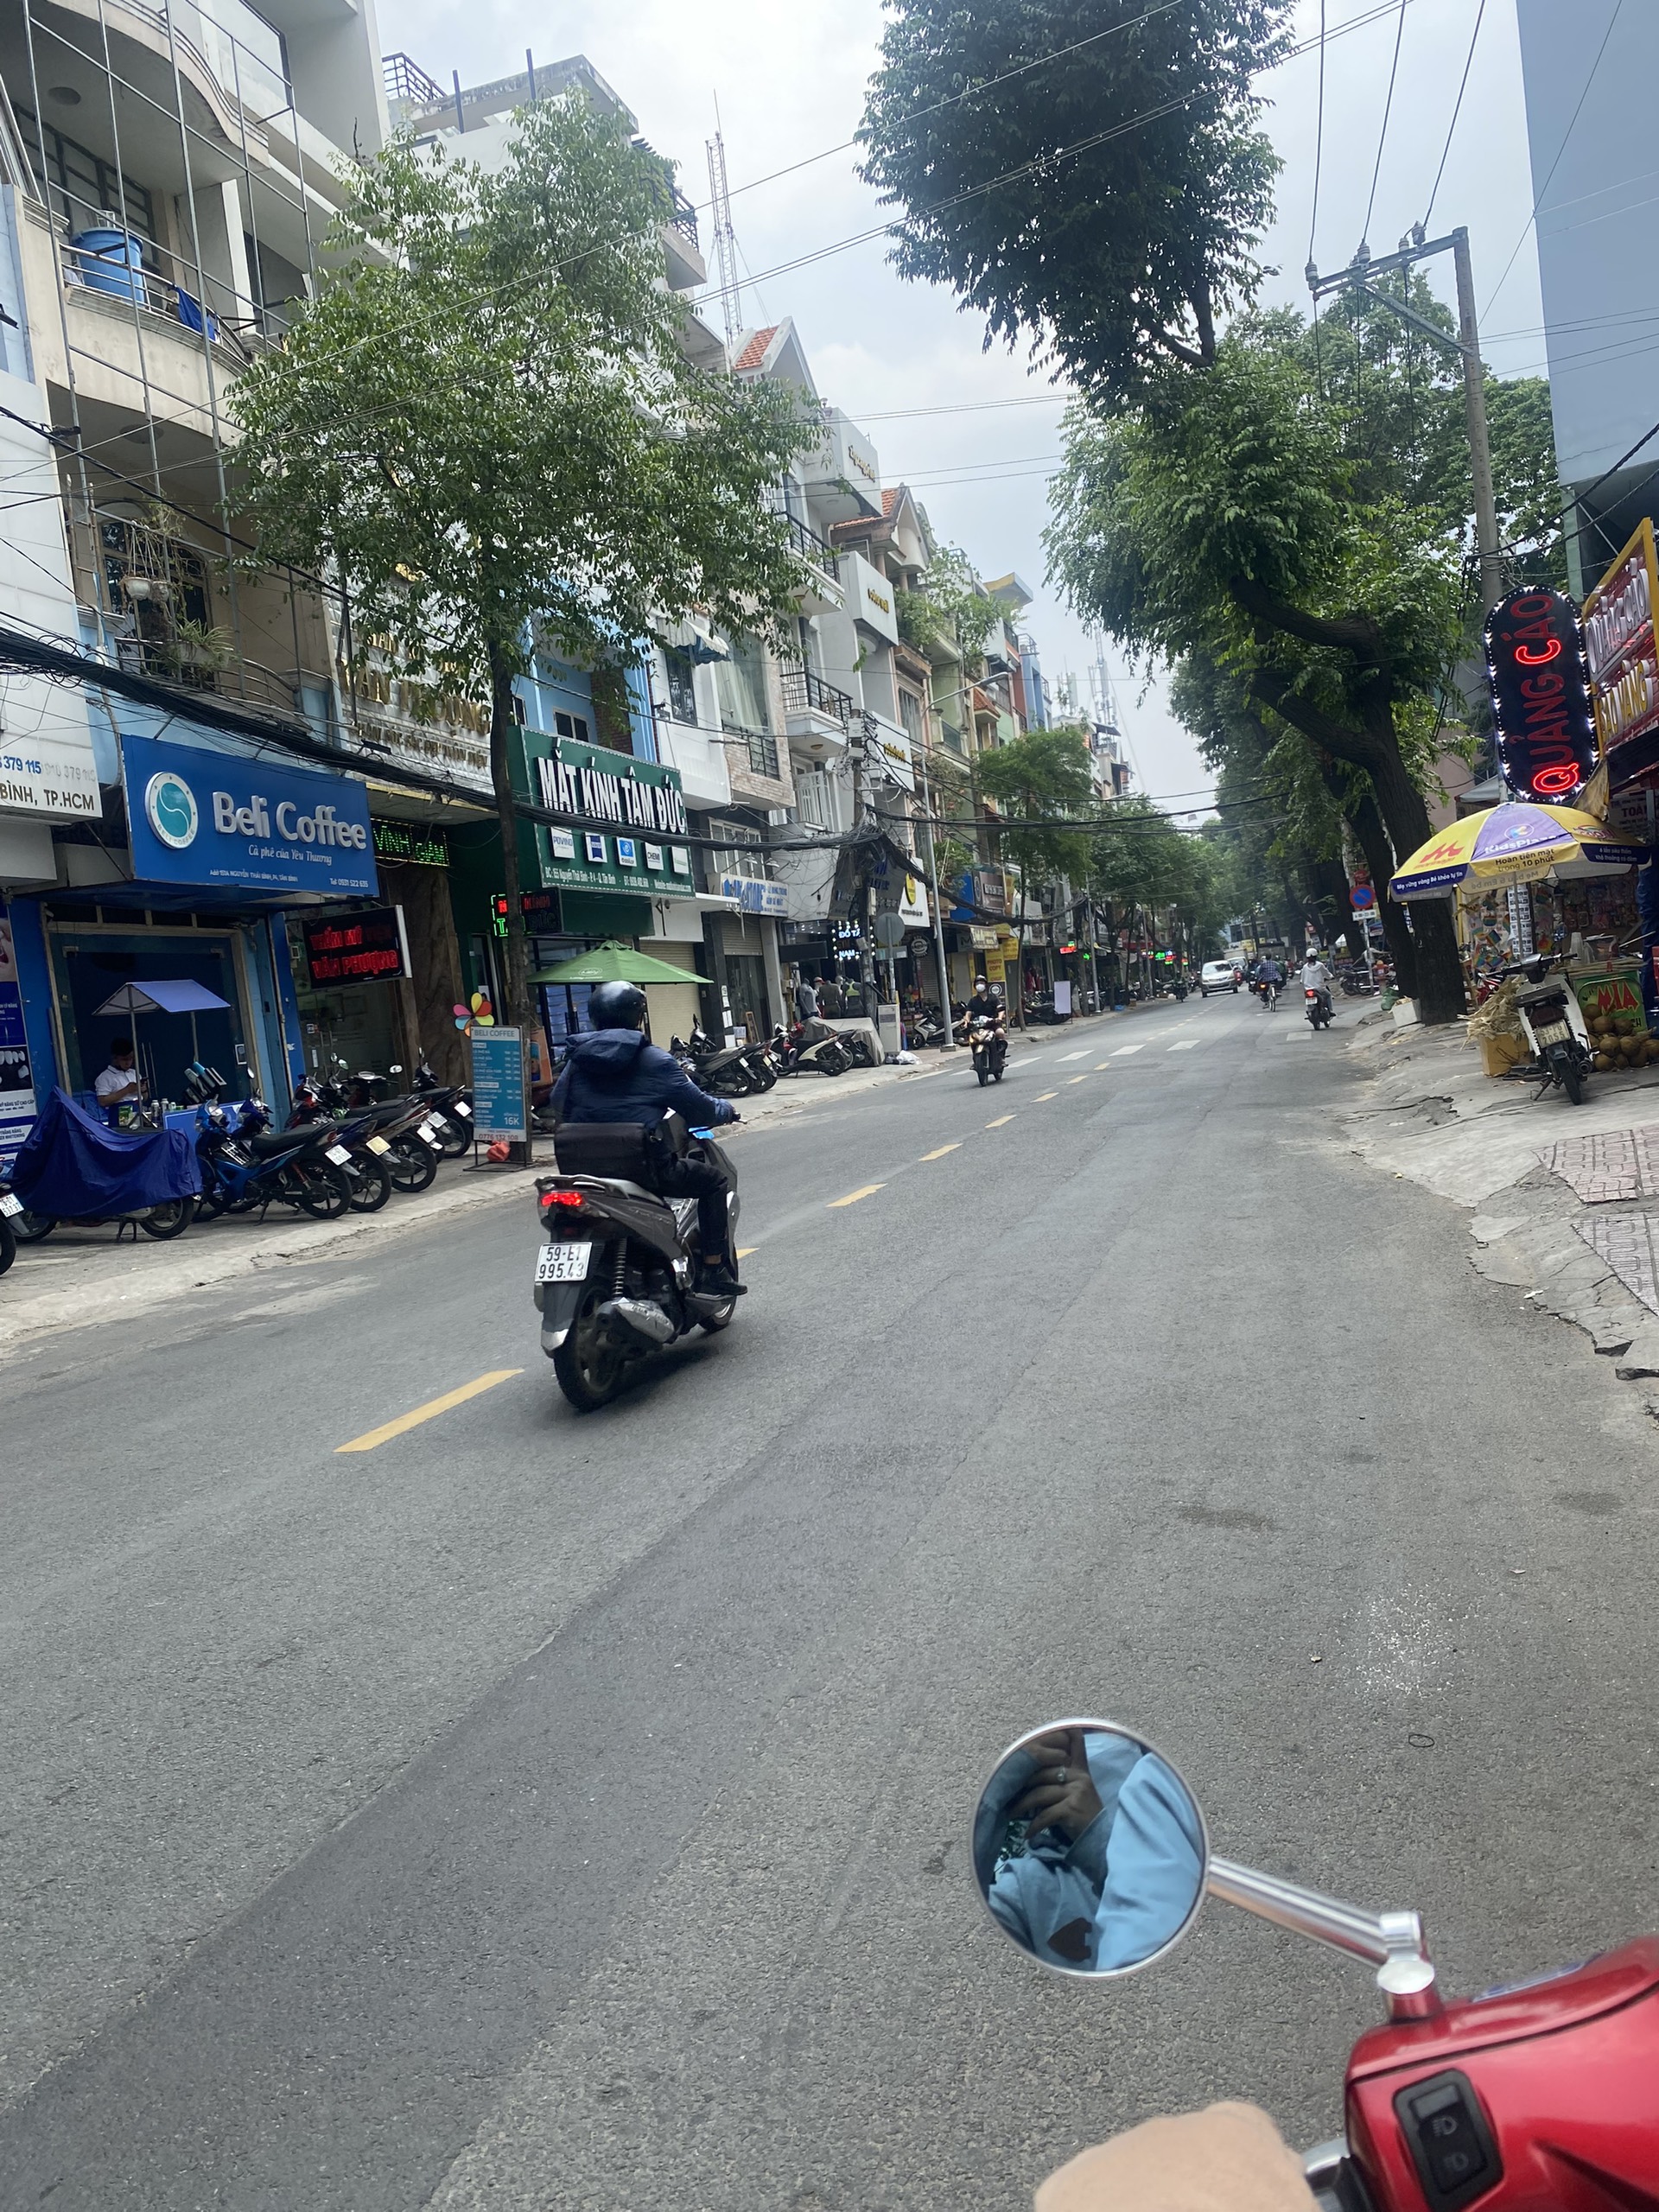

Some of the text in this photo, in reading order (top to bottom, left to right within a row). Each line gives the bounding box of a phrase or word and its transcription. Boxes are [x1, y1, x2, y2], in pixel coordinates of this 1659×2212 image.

[1501, 594, 1580, 793] QUẢNG CÁO
[3, 755, 41, 774] 379 115
[0, 779, 94, 810] BÌNH, TP.HCM
[537, 737, 686, 834] MẮT KÍNH TÂM ĐỨC
[213, 791, 366, 849] Beli Coffee
[249, 844, 332, 866] Cà phê của Yêu Thương
[647, 851, 660, 861] CHEMI
[1495, 849, 1554, 866] Hoàn tiền mặt
[1497, 855, 1555, 873] trong 10 phút
[504, 1116, 519, 1125] 16K
[546, 1246, 582, 1262] 59-E1
[538, 1262, 584, 1279] 995.43
